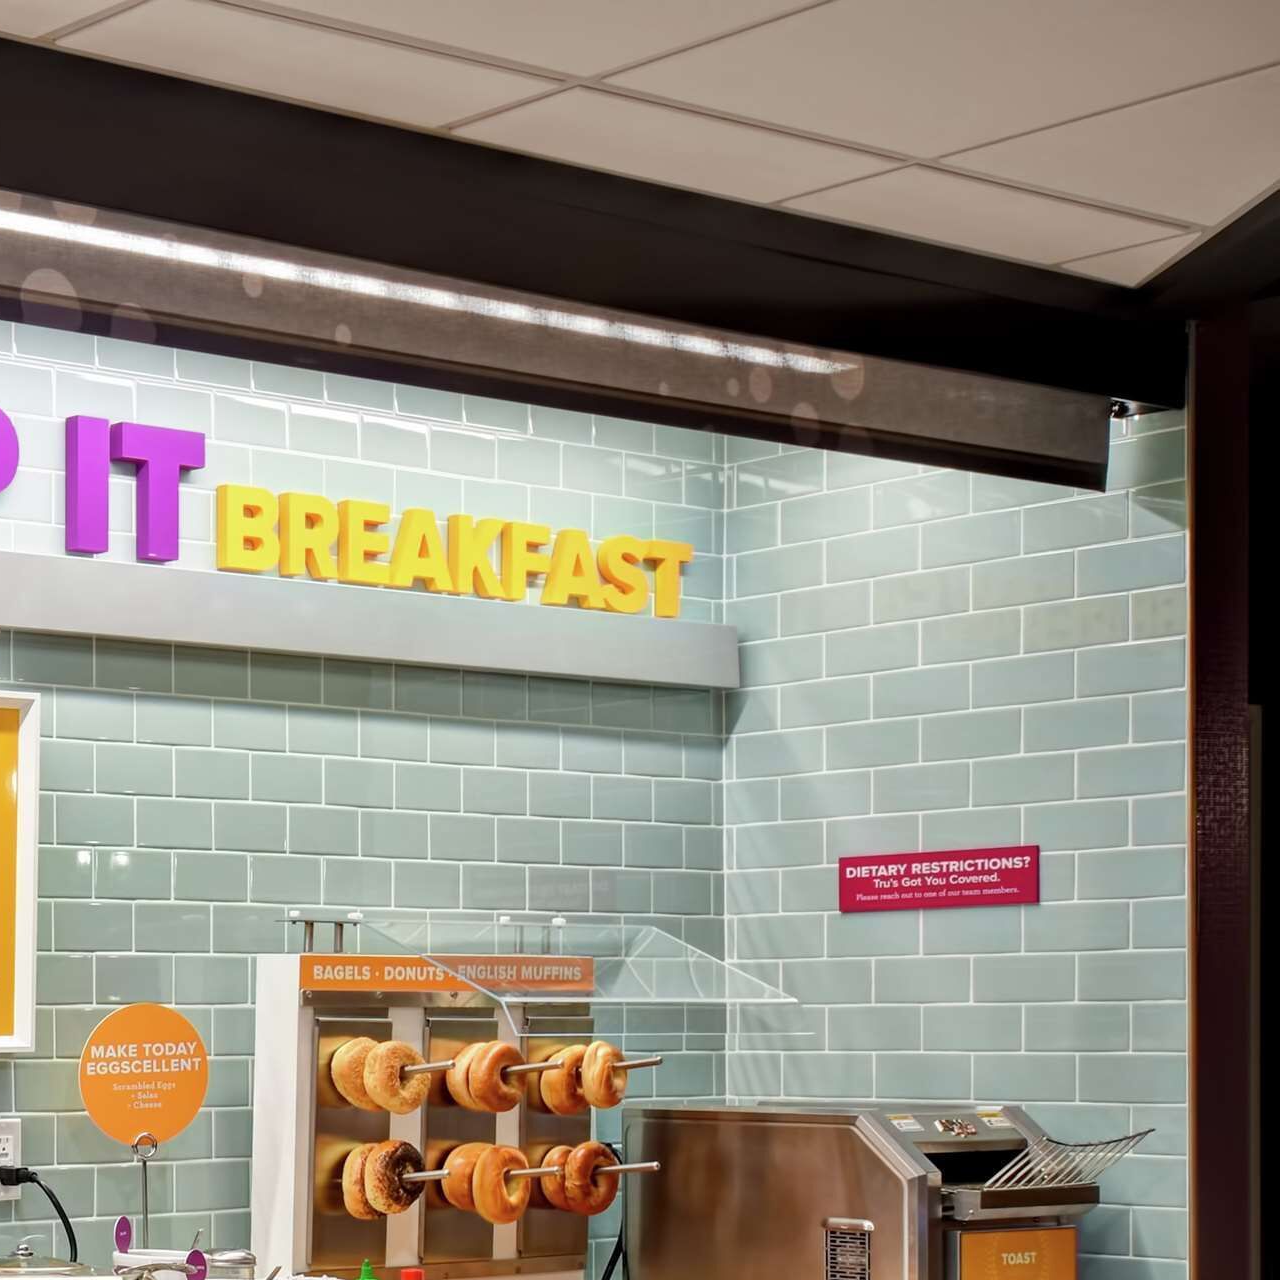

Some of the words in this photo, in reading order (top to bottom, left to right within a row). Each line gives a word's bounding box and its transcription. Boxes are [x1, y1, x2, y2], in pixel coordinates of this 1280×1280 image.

[65, 414, 205, 562] IT
[215, 484, 693, 618] BREAKFAST
[846, 864, 908, 878] DIETARY
[912, 856, 1031, 875] RESTRICTIONS?
[873, 878, 898, 888] Tru's
[902, 877, 921, 887] Got
[925, 876, 946, 886] You
[949, 872, 1001, 884] Covered.
[856, 893, 878, 901] Please
[880, 891, 899, 899] reach
[924, 890, 937, 898] one
[939, 888, 946, 897] of
[982, 886, 1020, 895] members.
[313, 965, 370, 980] BAGELS
[384, 966, 444, 981] DONUTS
[457, 966, 515, 980] ENGLISH
[521, 966, 582, 980] MUFFINS
[90, 1044, 137, 1058] MAKE
[142, 1041, 197, 1056] TODAY
[86, 1058, 201, 1075] EGGSCELLENT
[113, 1081, 155, 1091] Scrambled
[157, 1081, 175, 1090] Eggs
[137, 1091, 158, 1099] Salsa
[133, 1101, 162, 1109] Cheese
[1001, 1252, 1036, 1265] TOAST
